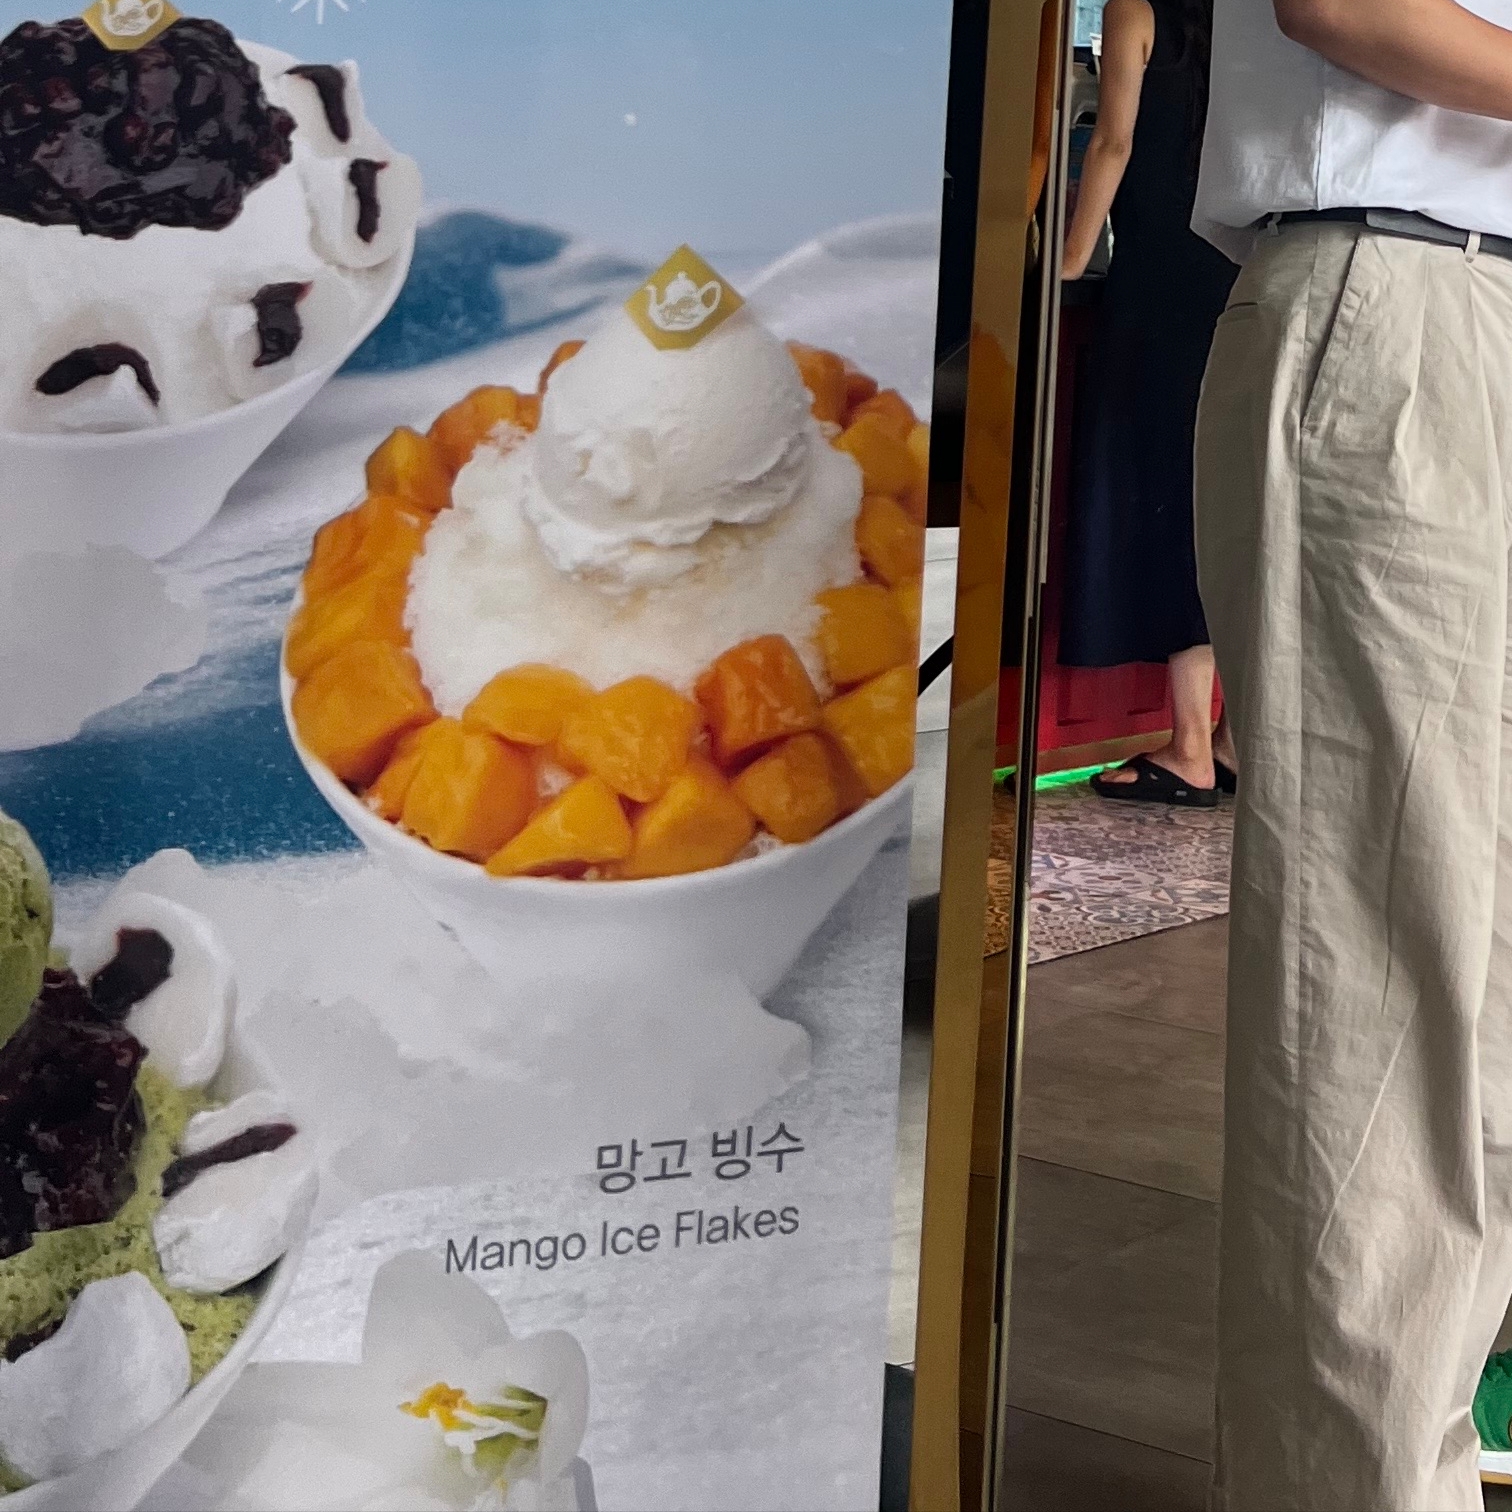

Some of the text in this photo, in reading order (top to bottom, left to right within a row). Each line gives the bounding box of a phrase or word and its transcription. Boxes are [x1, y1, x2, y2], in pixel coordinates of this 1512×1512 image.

[596, 1122, 806, 1194] 망고 빙수
[445, 1204, 801, 1274] Mango Ice Flakes
